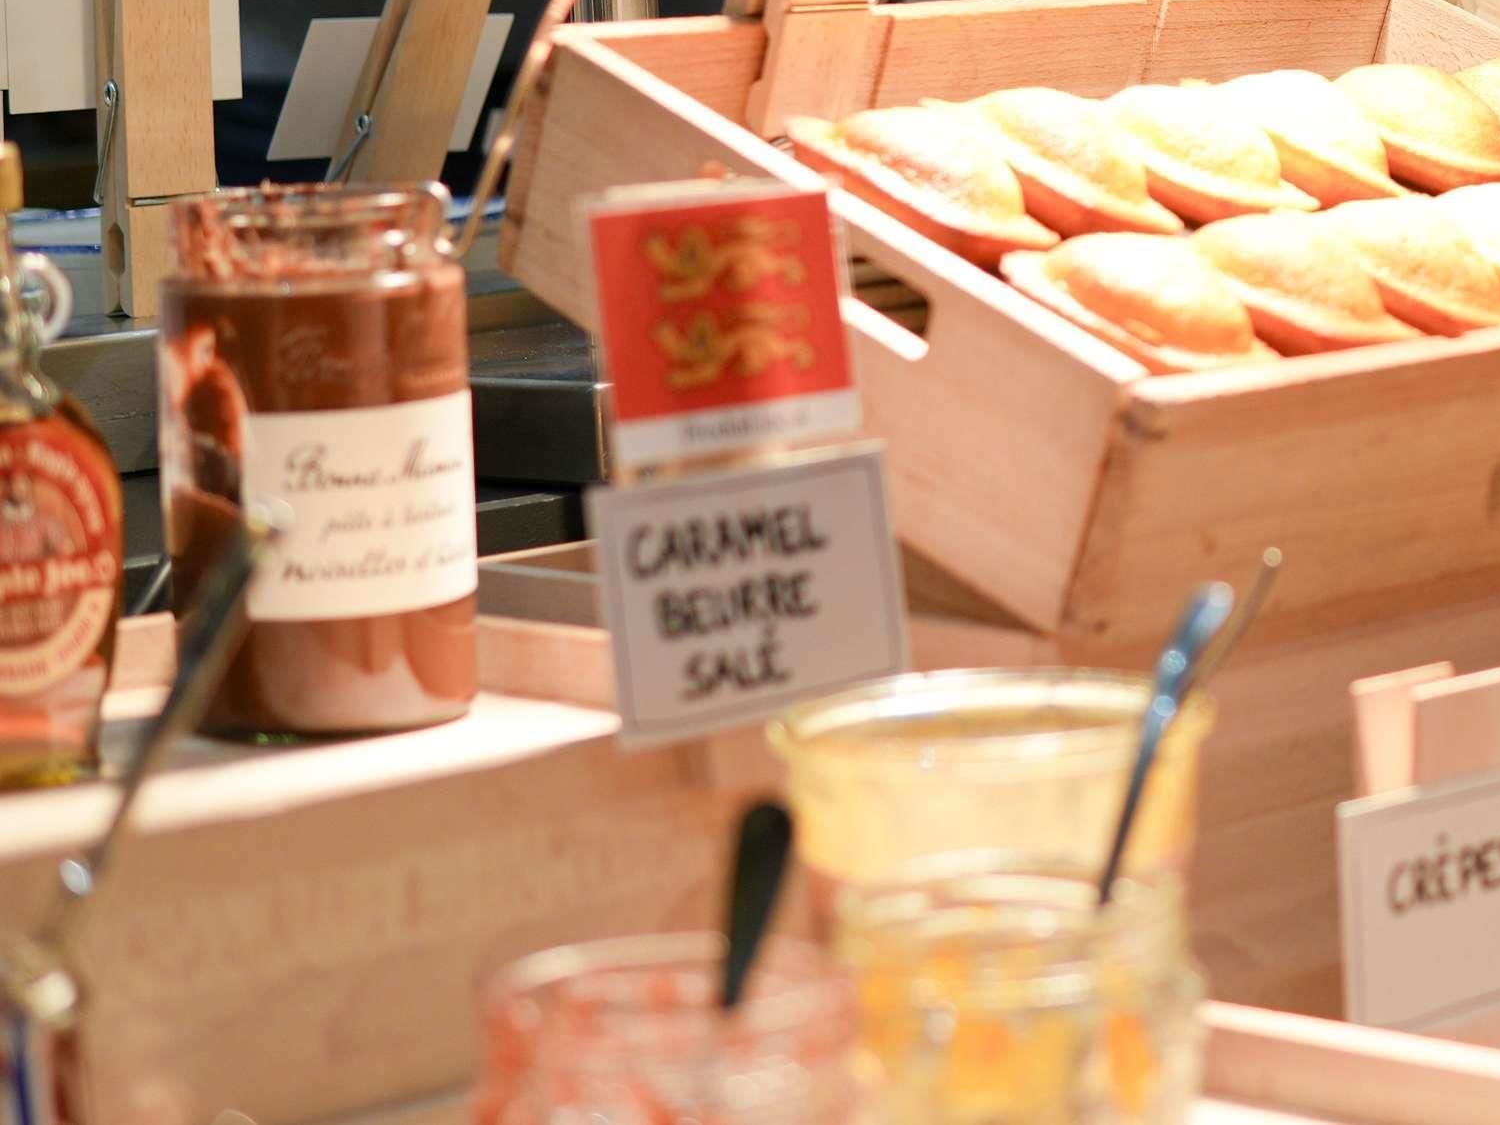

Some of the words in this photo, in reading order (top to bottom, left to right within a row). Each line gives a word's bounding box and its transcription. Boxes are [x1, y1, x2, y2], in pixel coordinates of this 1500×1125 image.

[625, 503, 830, 581] CARAMEL
[655, 570, 819, 641] BEURRE
[680, 623, 793, 702] SALÉ
